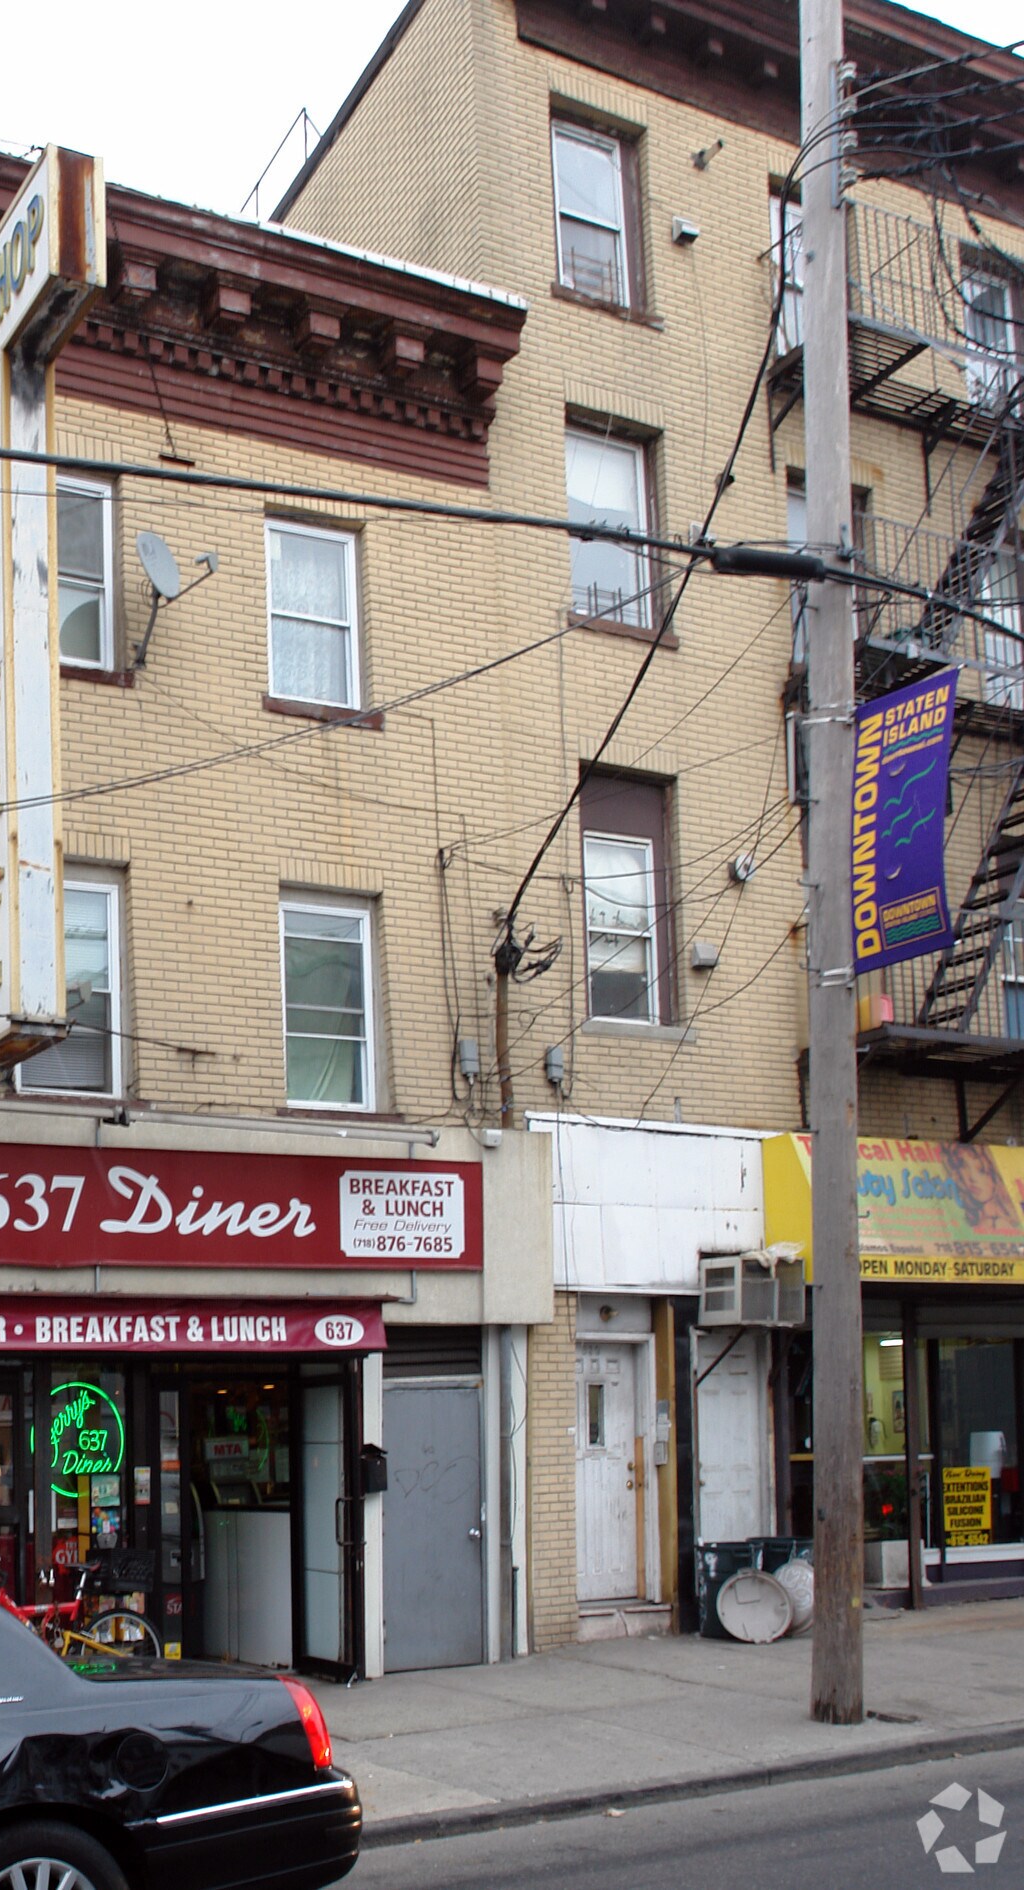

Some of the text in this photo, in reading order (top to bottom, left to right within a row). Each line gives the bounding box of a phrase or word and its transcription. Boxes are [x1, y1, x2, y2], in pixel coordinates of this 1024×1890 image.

[884, 685, 950, 726] STATEN
[882, 706, 947, 747] ISLAND
[853, 711, 884, 959] DOWNTOWN
[349, 1178, 455, 1198] BREAKFAST
[100, 1164, 316, 1238] Diner
[362, 1199, 444, 1218] & LUNCH
[353, 1219, 452, 1235] Free Delivery
[894, 1261, 947, 1276] MONDAY
[954, 1262, 1015, 1277] SATURDAY
[35, 1316, 180, 1343] BREAKFAST
[187, 1316, 204, 1342] &
[211, 1316, 287, 1342] LUNCH
[326, 1321, 354, 1341] 637
[78, 1430, 108, 1452] 637
[213, 1443, 243, 1456] MTA
